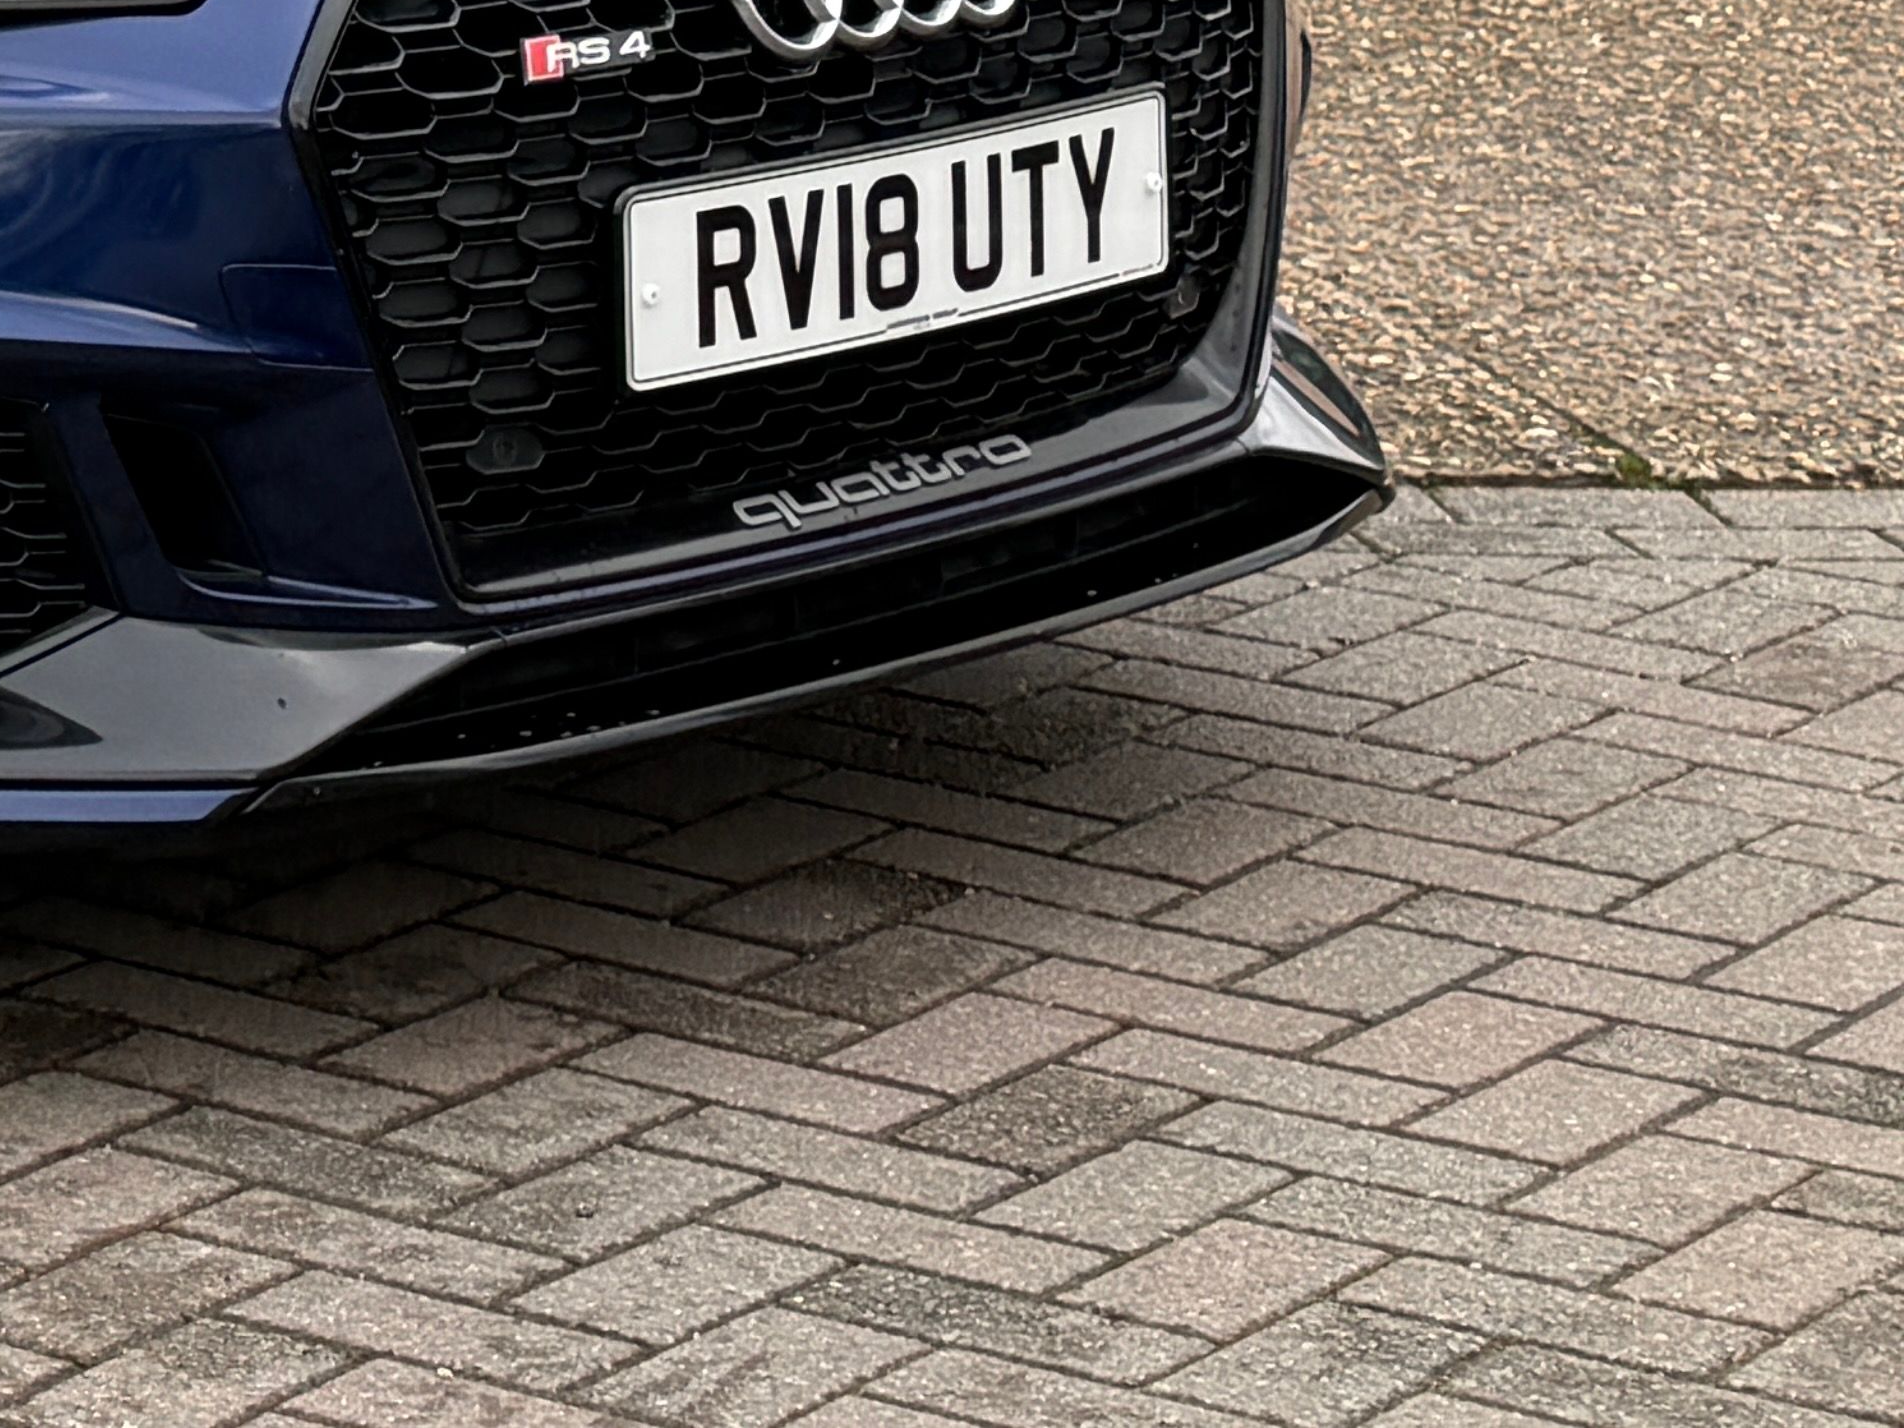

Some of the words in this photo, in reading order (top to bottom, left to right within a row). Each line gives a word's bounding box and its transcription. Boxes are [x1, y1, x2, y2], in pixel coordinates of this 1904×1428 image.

[546, 37, 611, 73] RS
[619, 30, 651, 59] 4
[695, 173, 921, 348] RV18
[950, 127, 1116, 291] UTY
[732, 433, 1033, 530] quattro
